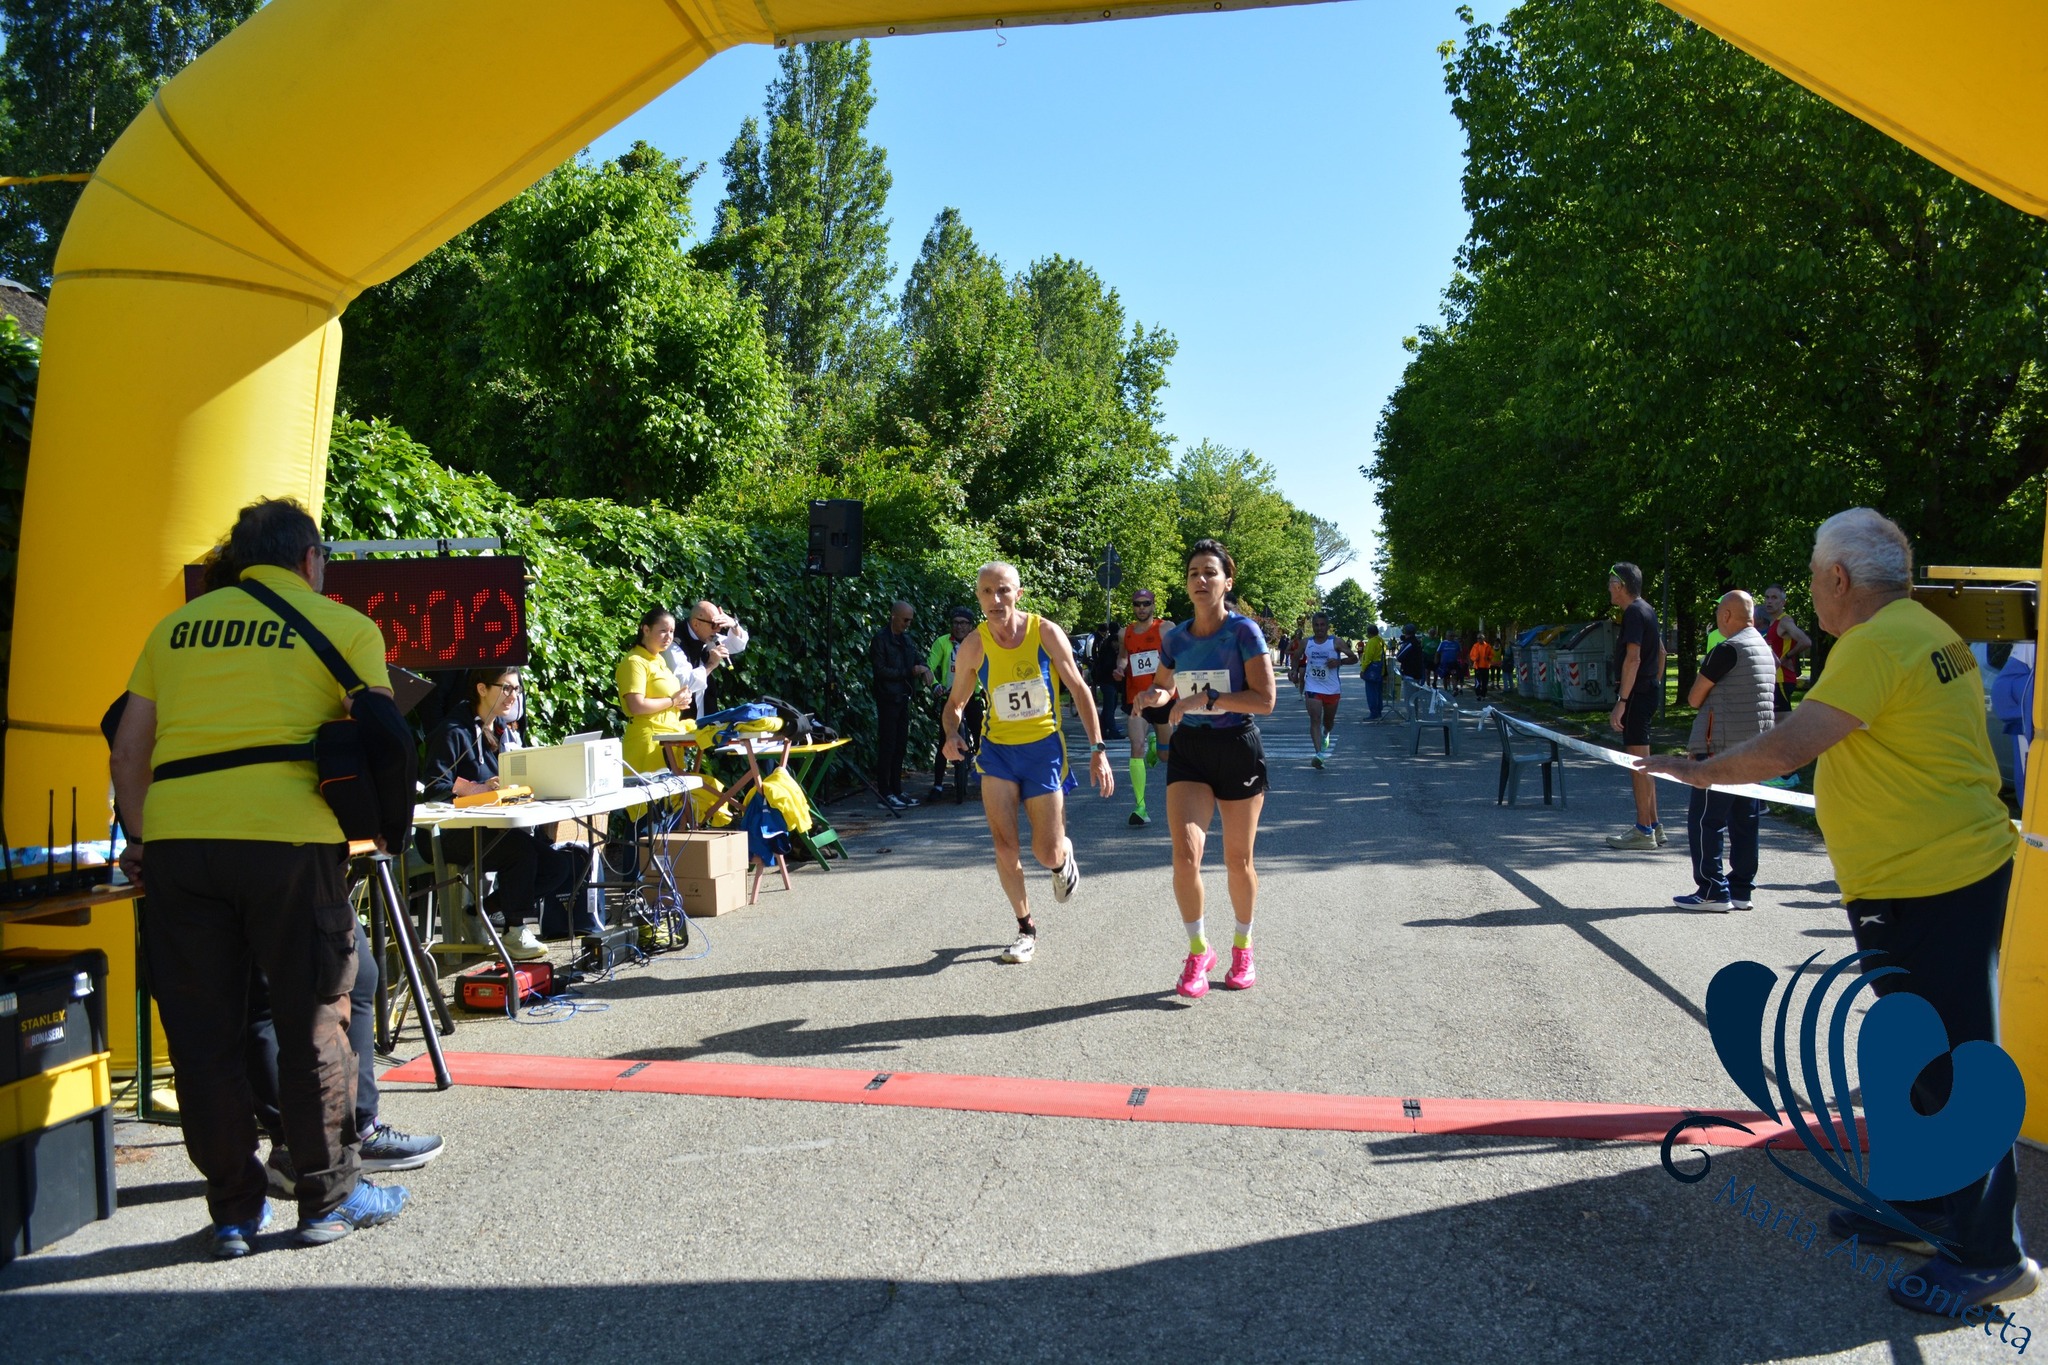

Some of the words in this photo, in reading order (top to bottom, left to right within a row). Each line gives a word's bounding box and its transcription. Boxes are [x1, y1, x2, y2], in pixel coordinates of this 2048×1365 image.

[170, 619, 298, 650] GIUDICE
[1137, 657, 1152, 670] 84
[1311, 668, 1326, 678] 328
[1008, 690, 1032, 711] 51
[21, 1009, 66, 1033] STANLEY
[31, 1026, 65, 1047] BONASERA
